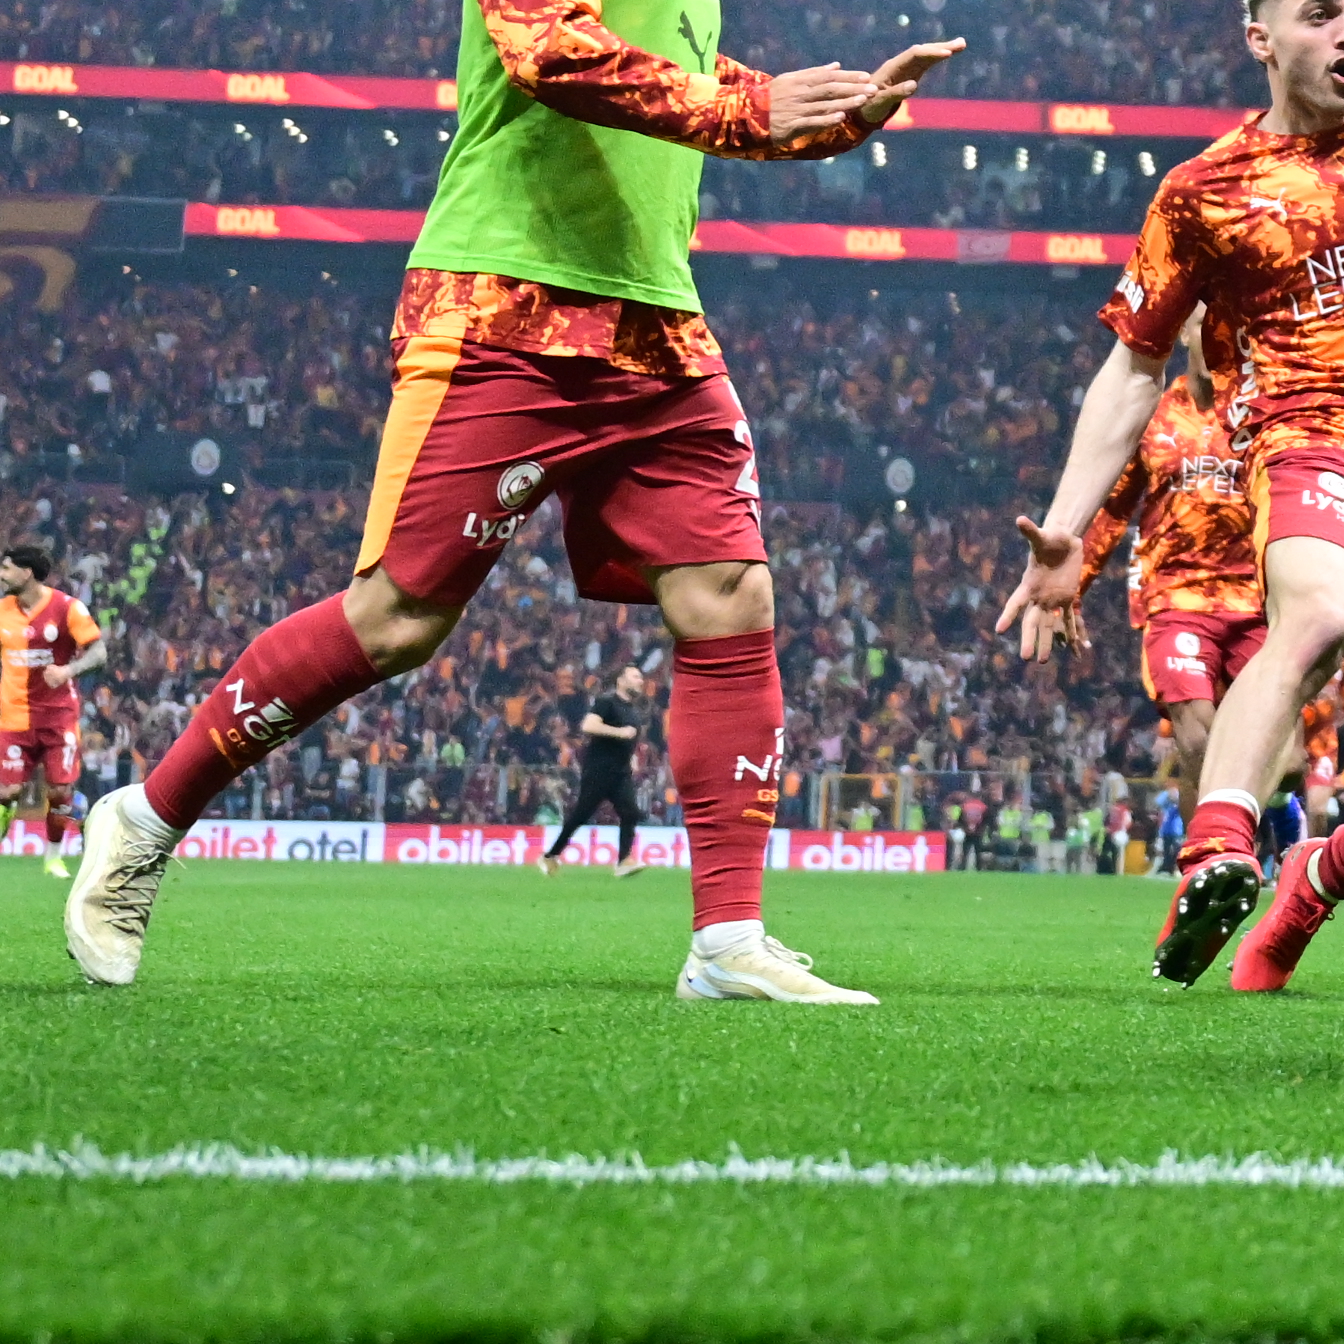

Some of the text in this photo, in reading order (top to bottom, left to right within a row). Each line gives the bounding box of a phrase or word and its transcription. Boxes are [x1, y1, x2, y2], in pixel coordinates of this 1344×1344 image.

[14, 65, 79, 93] GOAL
[227, 74, 291, 102] GOAL
[1052, 105, 1115, 135] GOAL
[217, 207, 280, 235] GOAL
[845, 229, 906, 258] GOAL
[1047, 235, 1108, 264] GOAL
[1182, 455, 1245, 474] NEXT
[1169, 473, 1244, 495] LEVEL
[288, 828, 368, 862] otel
[397, 824, 528, 865] obilet
[802, 834, 929, 872] obilet
